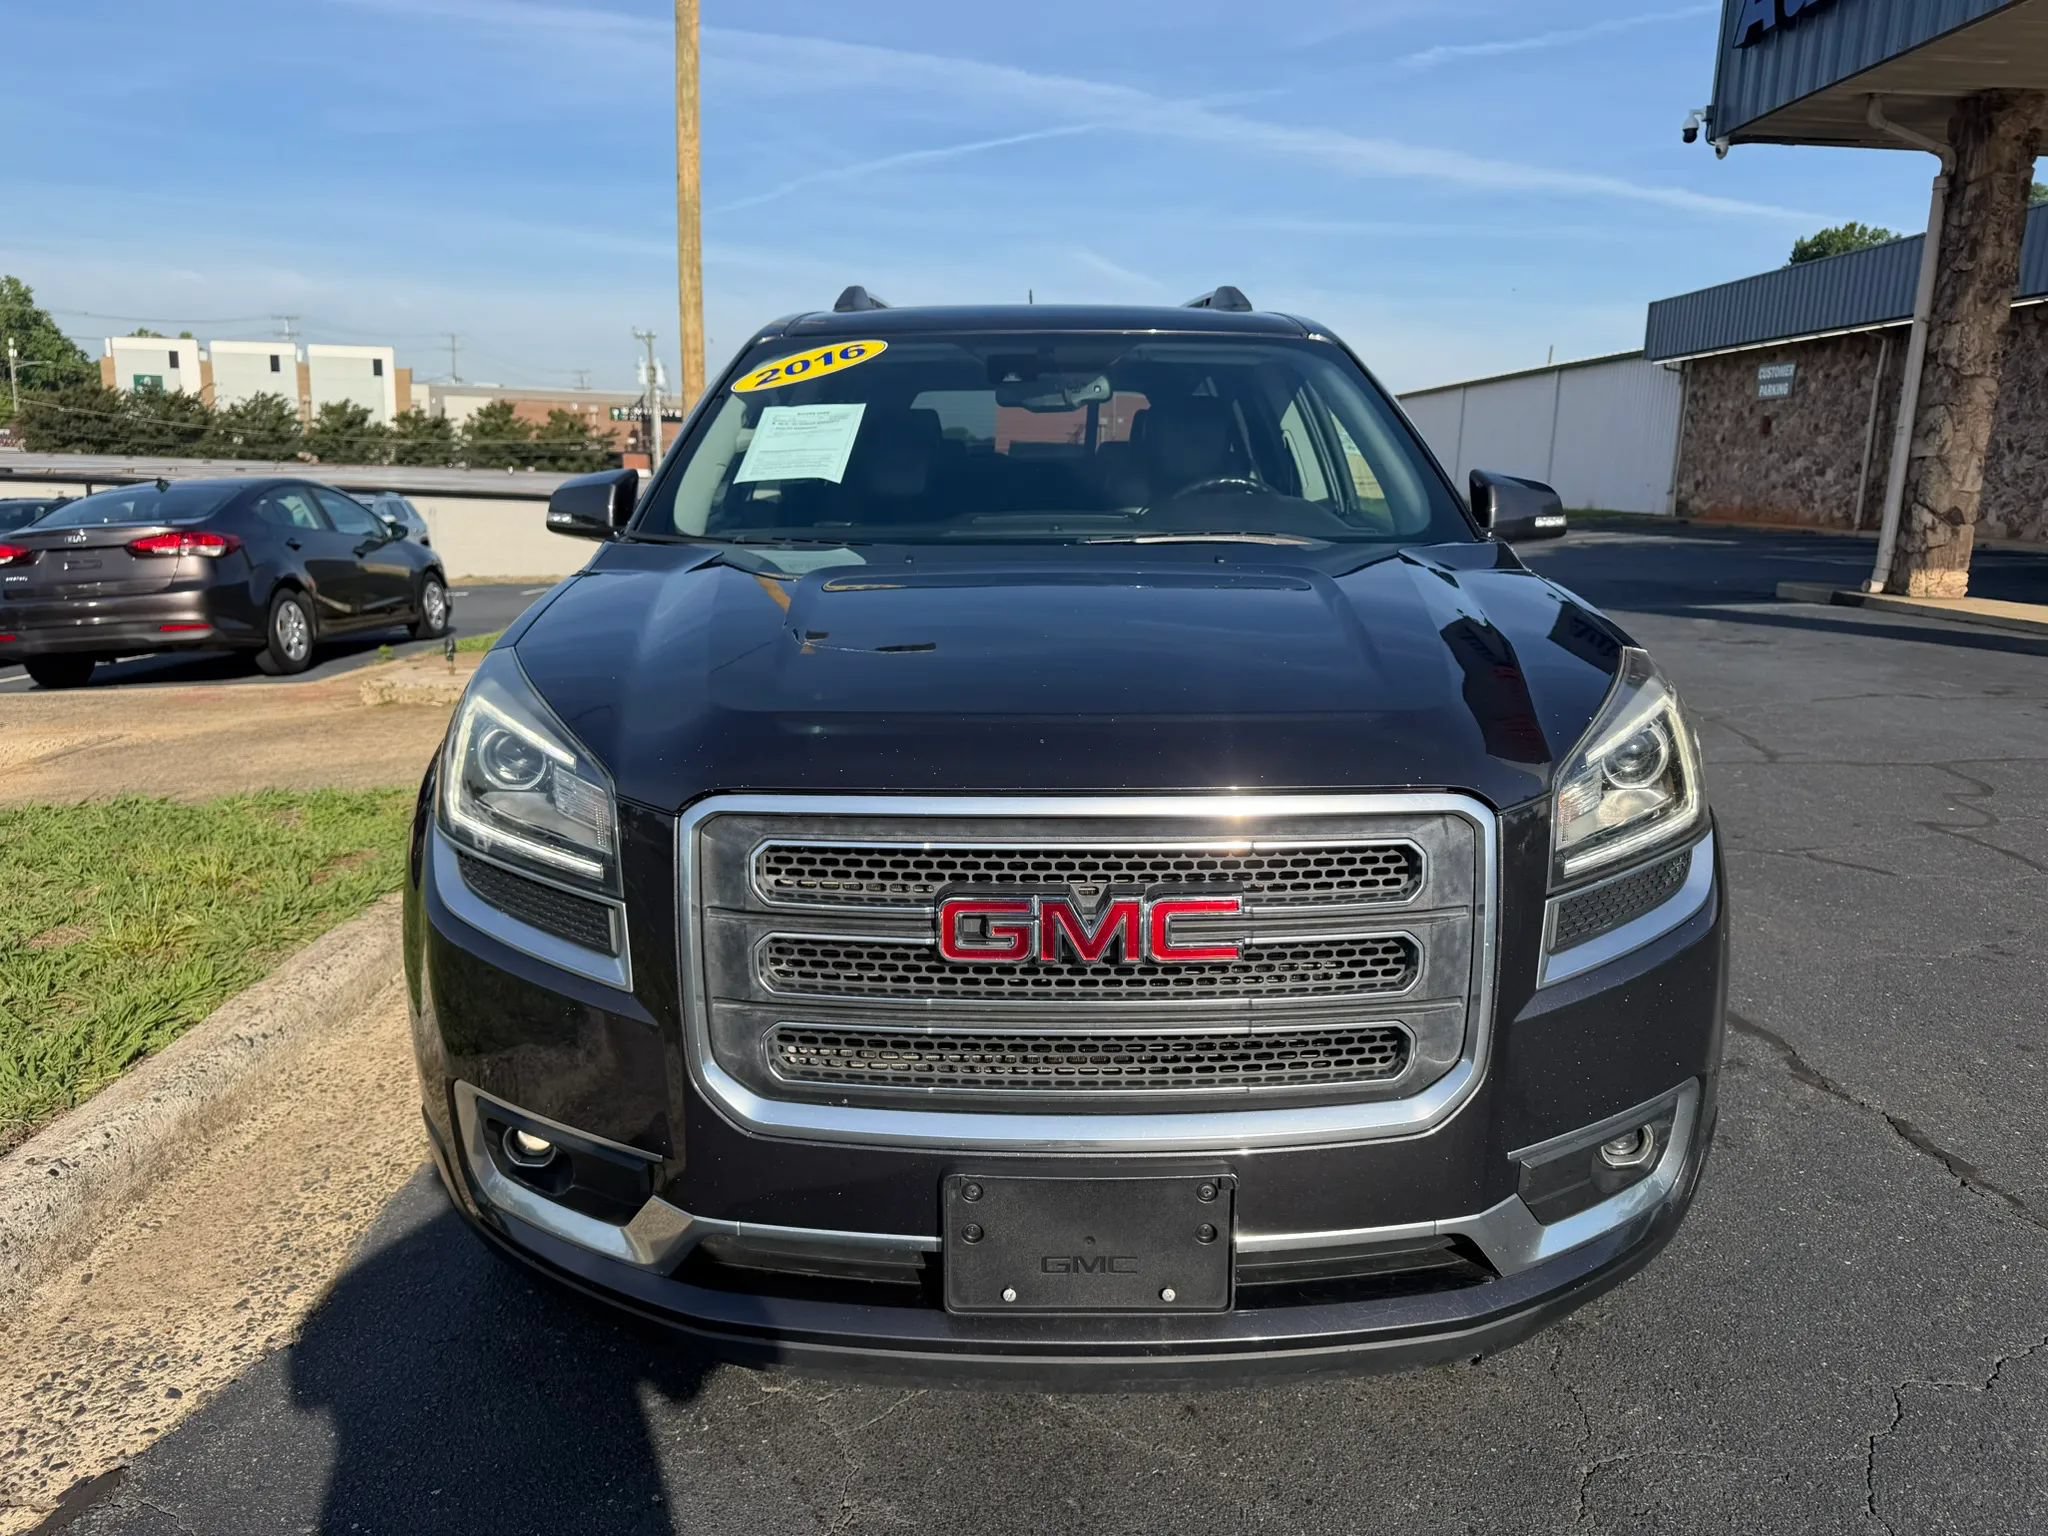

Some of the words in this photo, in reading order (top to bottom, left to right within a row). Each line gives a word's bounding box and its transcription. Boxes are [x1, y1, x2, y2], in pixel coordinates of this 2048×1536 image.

[754, 344, 866, 387] 2016
[1758, 364, 1795, 380] CUSTOMER
[1758, 382, 1789, 397] PARKING
[938, 895, 1245, 965] GMC
[1041, 1255, 1138, 1274] GMC
